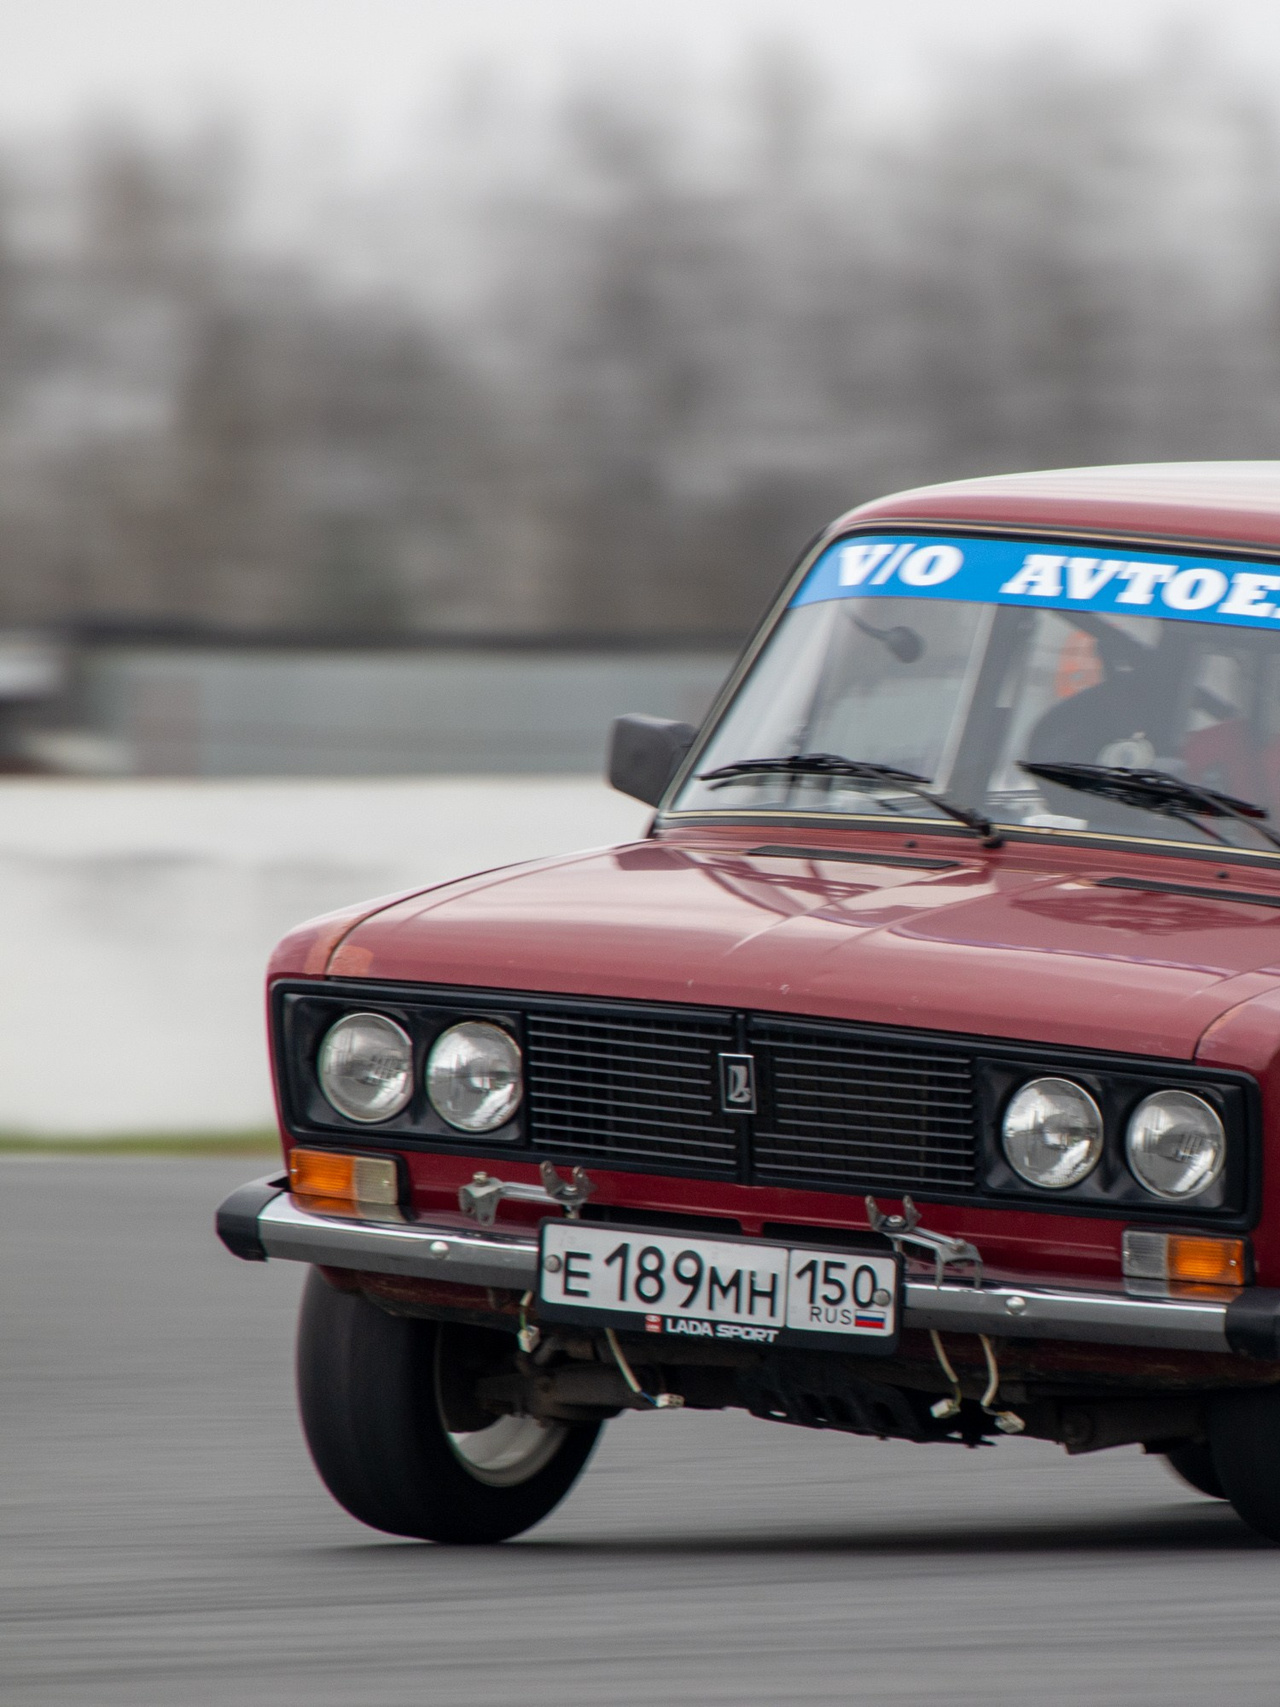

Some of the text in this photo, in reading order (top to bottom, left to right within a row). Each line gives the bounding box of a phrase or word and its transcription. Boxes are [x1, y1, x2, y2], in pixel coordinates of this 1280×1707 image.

[838, 543, 965, 588] V/O
[795, 1259, 878, 1309] 150
[665, 1318, 714, 1337] LADA
[715, 1323, 780, 1343] SPORT
[809, 1305, 852, 1326] RUS
